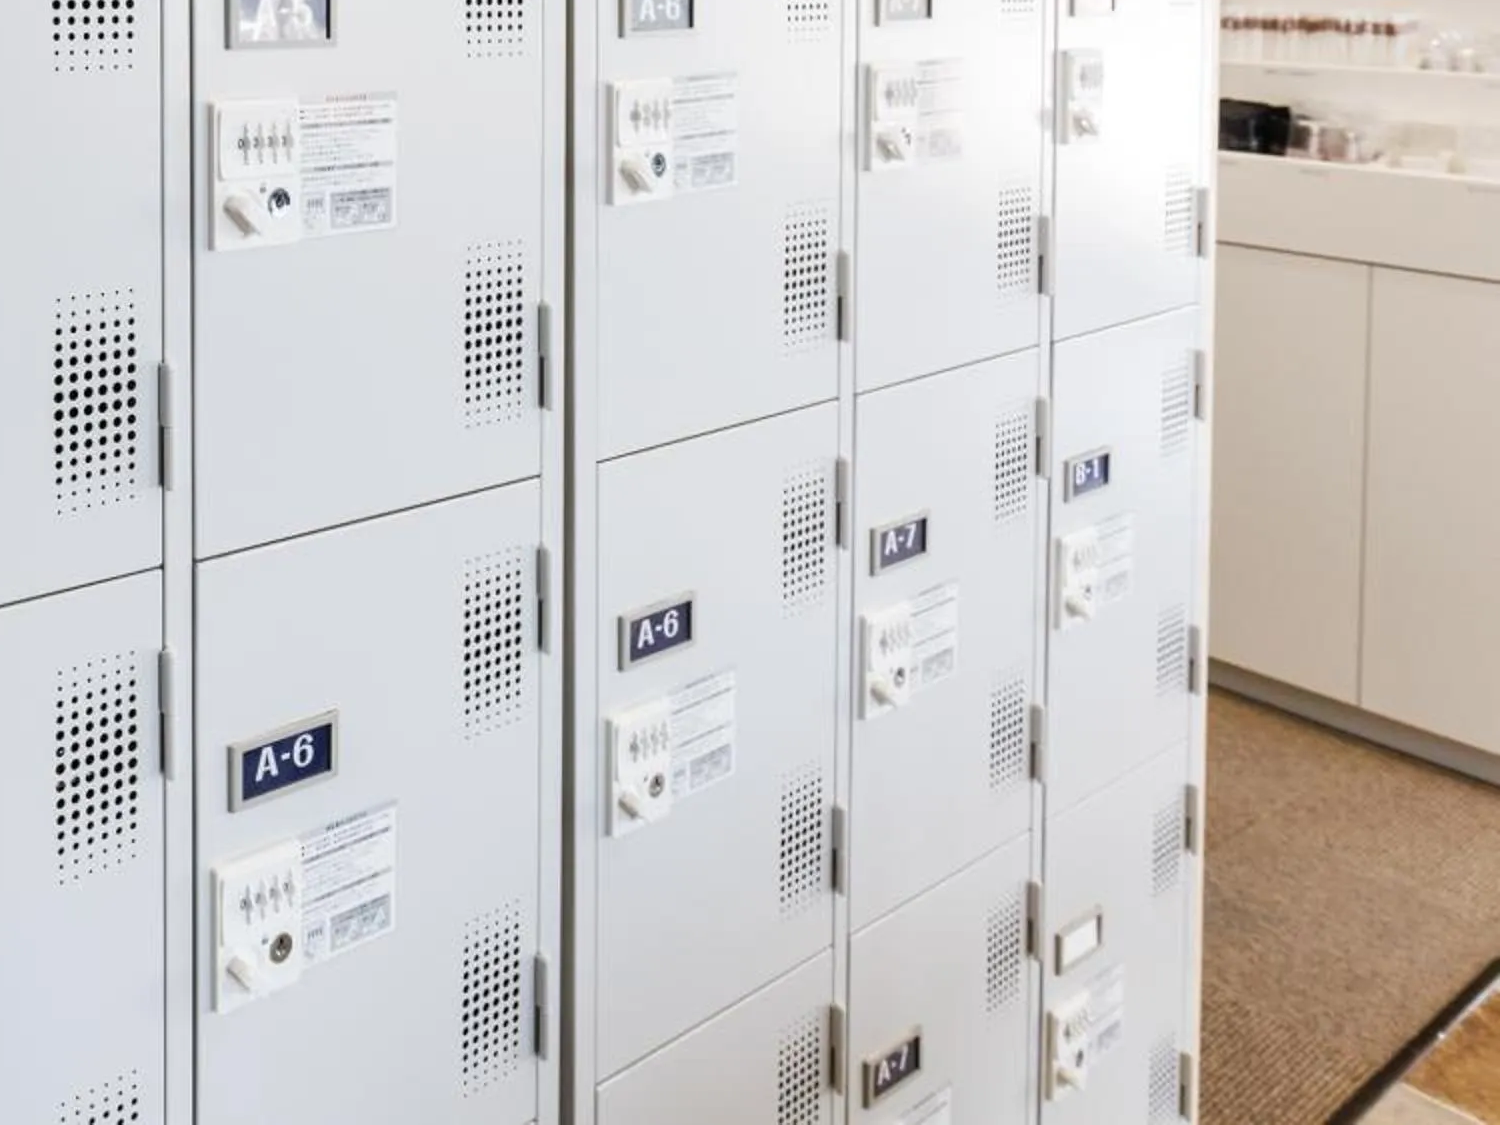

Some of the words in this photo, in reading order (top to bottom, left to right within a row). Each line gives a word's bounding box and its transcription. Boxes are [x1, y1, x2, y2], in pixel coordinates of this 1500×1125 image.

[884, 523, 917, 556] A-7
[637, 610, 679, 649] A-6
[255, 733, 315, 782] A-6
